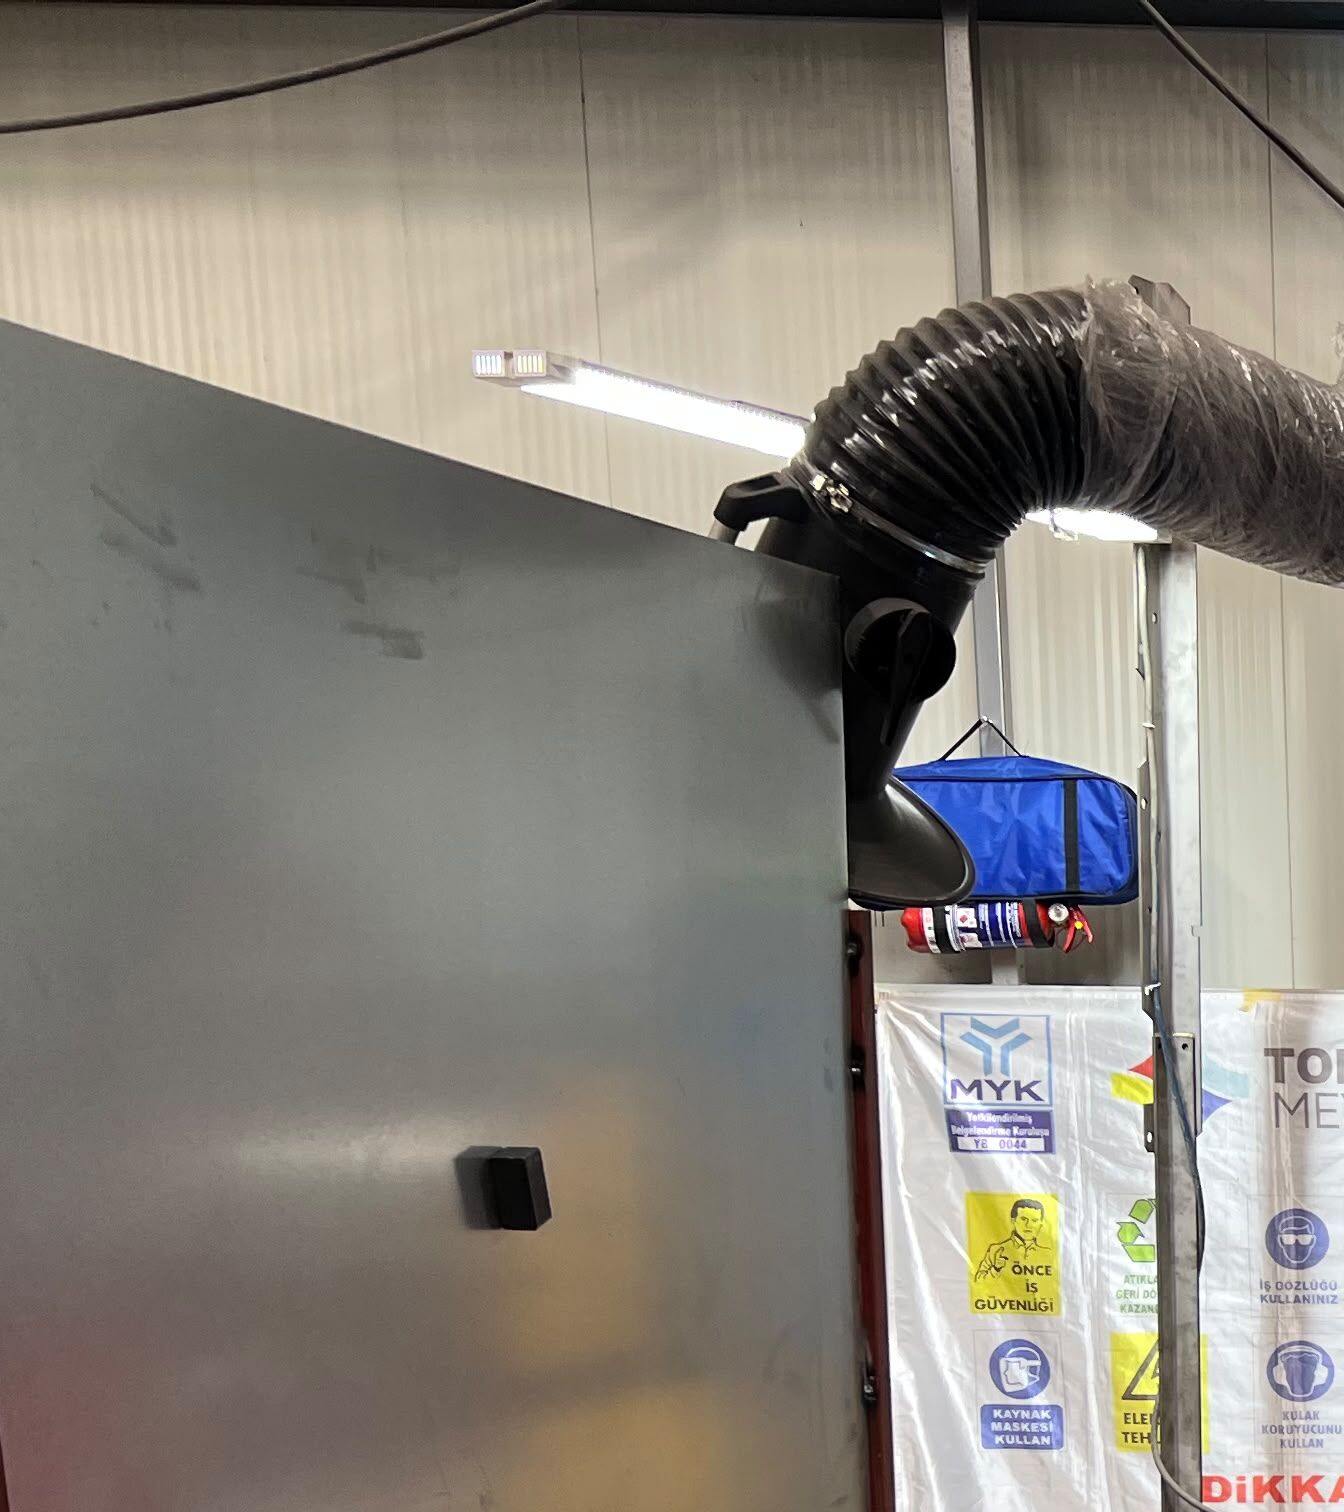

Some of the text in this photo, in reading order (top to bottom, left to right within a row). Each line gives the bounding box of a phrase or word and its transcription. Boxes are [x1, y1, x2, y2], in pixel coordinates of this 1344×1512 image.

[950, 1078, 1045, 1102] MYK
[999, 1139, 1027, 1150] 0044
[1011, 1261, 1052, 1277] ÖNCE
[1026, 1279, 1038, 1294] İŞ
[1259, 1278, 1271, 1293] İŞ
[974, 1295, 1054, 1313] GÜVENLİĞİ
[1260, 1294, 1339, 1305] KULLANINIZ
[992, 1408, 1052, 1420] KAYNAK
[1282, 1410, 1320, 1421] KULAK
[990, 1420, 1053, 1433] MASKESİ
[1261, 1424, 1342, 1435] KORUYUCUNU
[994, 1435, 1051, 1447] KULLAN
[1280, 1438, 1324, 1449] KULLAN
